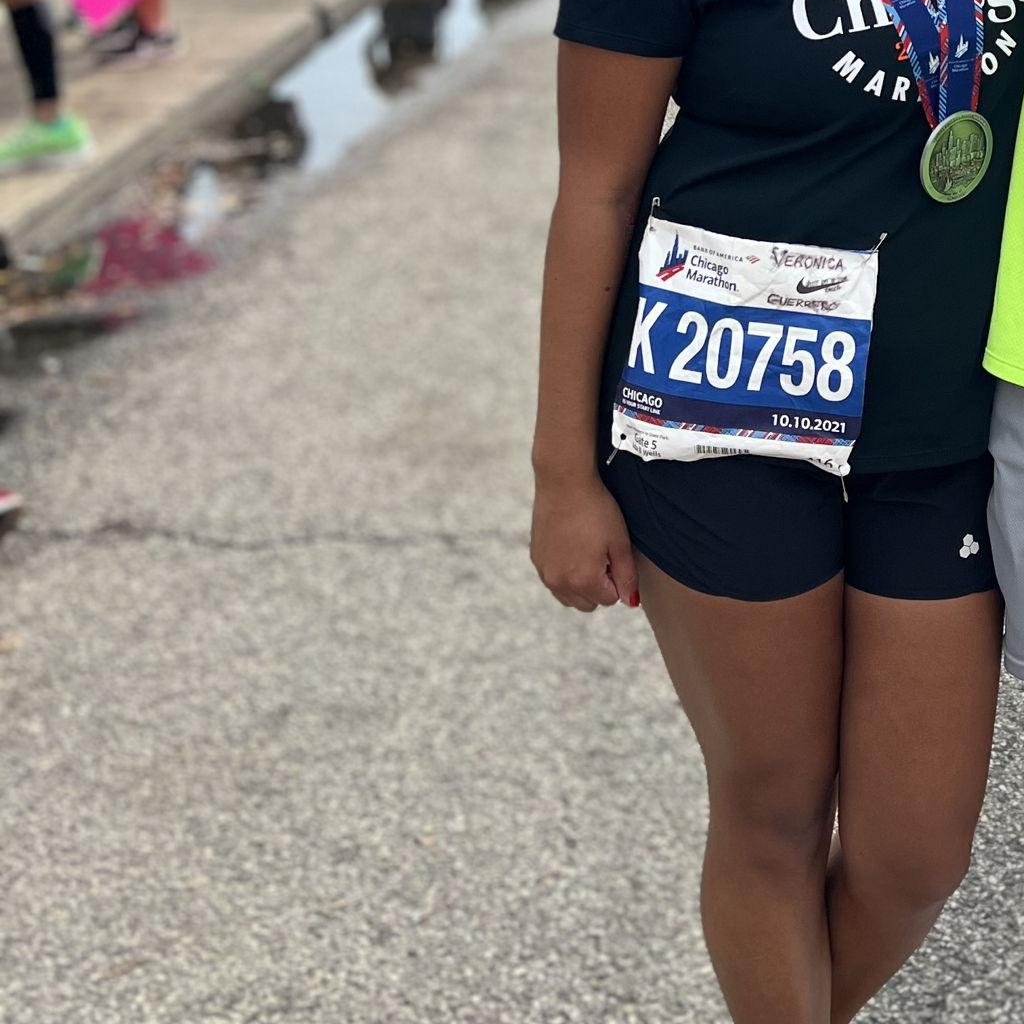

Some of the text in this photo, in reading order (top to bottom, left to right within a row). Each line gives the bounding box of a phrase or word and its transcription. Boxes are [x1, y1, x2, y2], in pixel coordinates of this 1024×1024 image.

[832, 29, 1018, 103] MARON
[690, 254, 729, 277] Chicago
[716, 252, 743, 262] AMERICA
[771, 246, 844, 272] VERONICA
[627, 296, 857, 402] K 20758
[622, 387, 663, 409] CHICAGO
[771, 414, 847, 435] 10.10.2021
[634, 432, 650, 448] Gate
